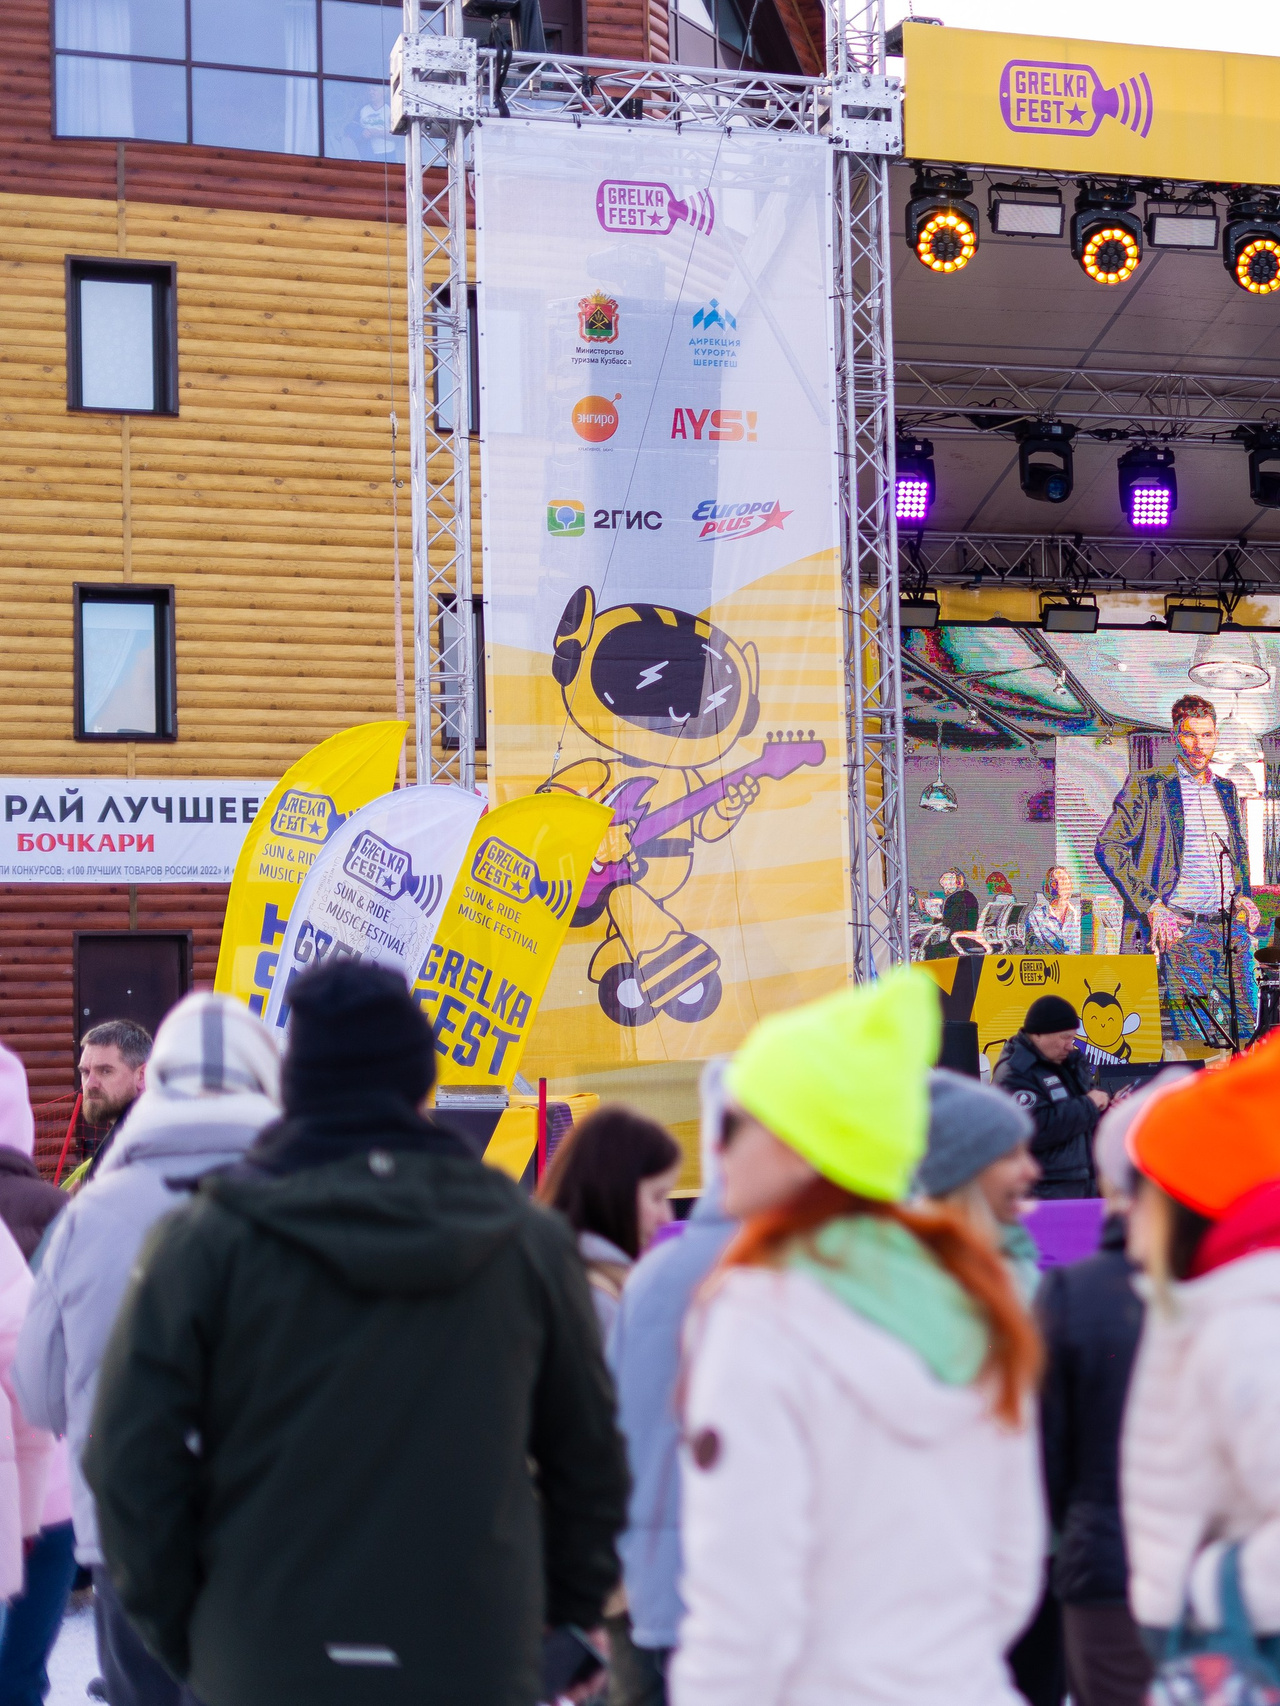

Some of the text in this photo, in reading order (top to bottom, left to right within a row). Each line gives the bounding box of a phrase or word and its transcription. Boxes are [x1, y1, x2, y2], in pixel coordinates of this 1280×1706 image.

[1015, 70, 1087, 98] GRELKA
[1016, 98, 1064, 124] FEST
[608, 187, 664, 207] GRELKA
[609, 207, 646, 226] FEST
[575, 347, 624, 356] Министерство
[689, 338, 740, 347] ДИРЕКЦИЯ
[694, 348, 736, 357] КУРОРТА
[600, 357, 632, 366] Кузбасса
[693, 358, 738, 367] ШЕРЕГЕШ
[577, 413, 614, 426] энгиро
[671, 407, 758, 442] AYS!
[593, 509, 663, 531] 2ГИС
[5, 788, 269, 823] РАЙ ЛУЧШЕЕ
[17, 833, 155, 852] БОЧКАРИ
[262, 843, 317, 866] SUN & RID
[360, 838, 405, 874] GRELKA
[487, 844, 531, 880] GRELKA
[12, 865, 65, 875] КОНКУРСОВ:
[67, 865, 84, 875] «100
[86, 865, 122, 875] ЛУЧШИХ
[124, 865, 162, 875] ТОВАРОВ
[165, 865, 198, 875] РОССИИ
[200, 865, 222, 875] 2022»
[259, 863, 295, 883] MUSIC
[350, 856, 385, 884] FEST
[478, 860, 511, 888] FEST
[334, 882, 391, 923] SUN & RIDE
[463, 886, 522, 923] SUN & RIDE
[326, 901, 361, 929] MUSIC
[360, 920, 405, 956] FESTIVAL
[458, 904, 538, 954] MUSIC FESTIVAL
[1023, 962, 1043, 972] GRELKA
[1024, 972, 1037, 982] FEST
[418, 943, 532, 1028] GRELKA
